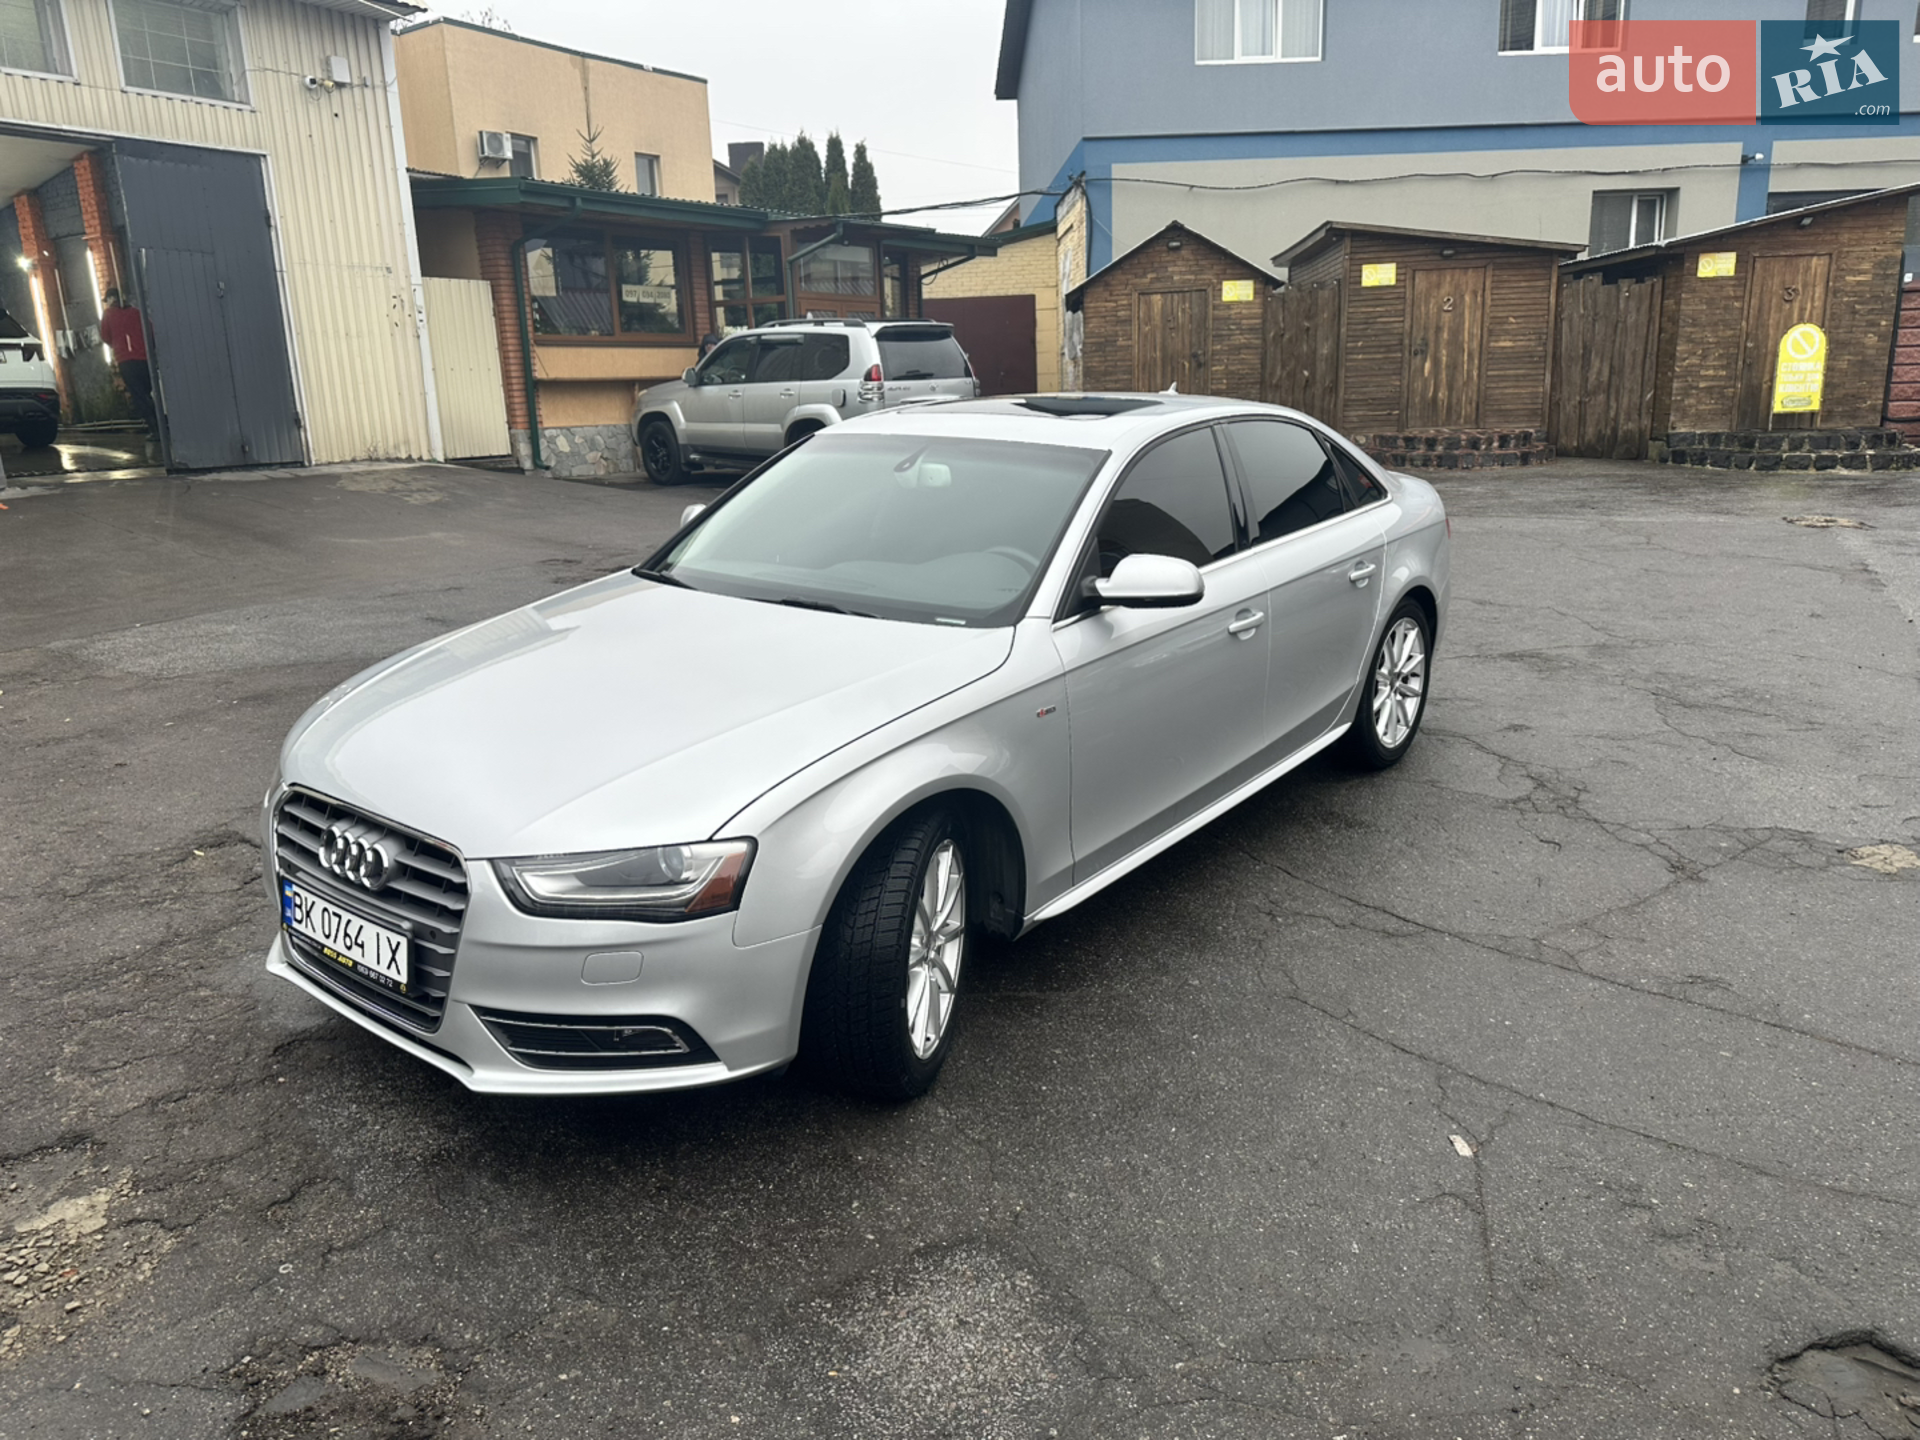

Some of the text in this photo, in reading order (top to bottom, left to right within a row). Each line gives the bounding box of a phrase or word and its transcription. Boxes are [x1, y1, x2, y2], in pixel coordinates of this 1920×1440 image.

[1783, 285, 1799, 302] 3
[1442, 296, 1454, 312] 2
[293, 890, 316, 933] BK
[321, 906, 365, 958] 0764
[376, 931, 401, 976] IX
